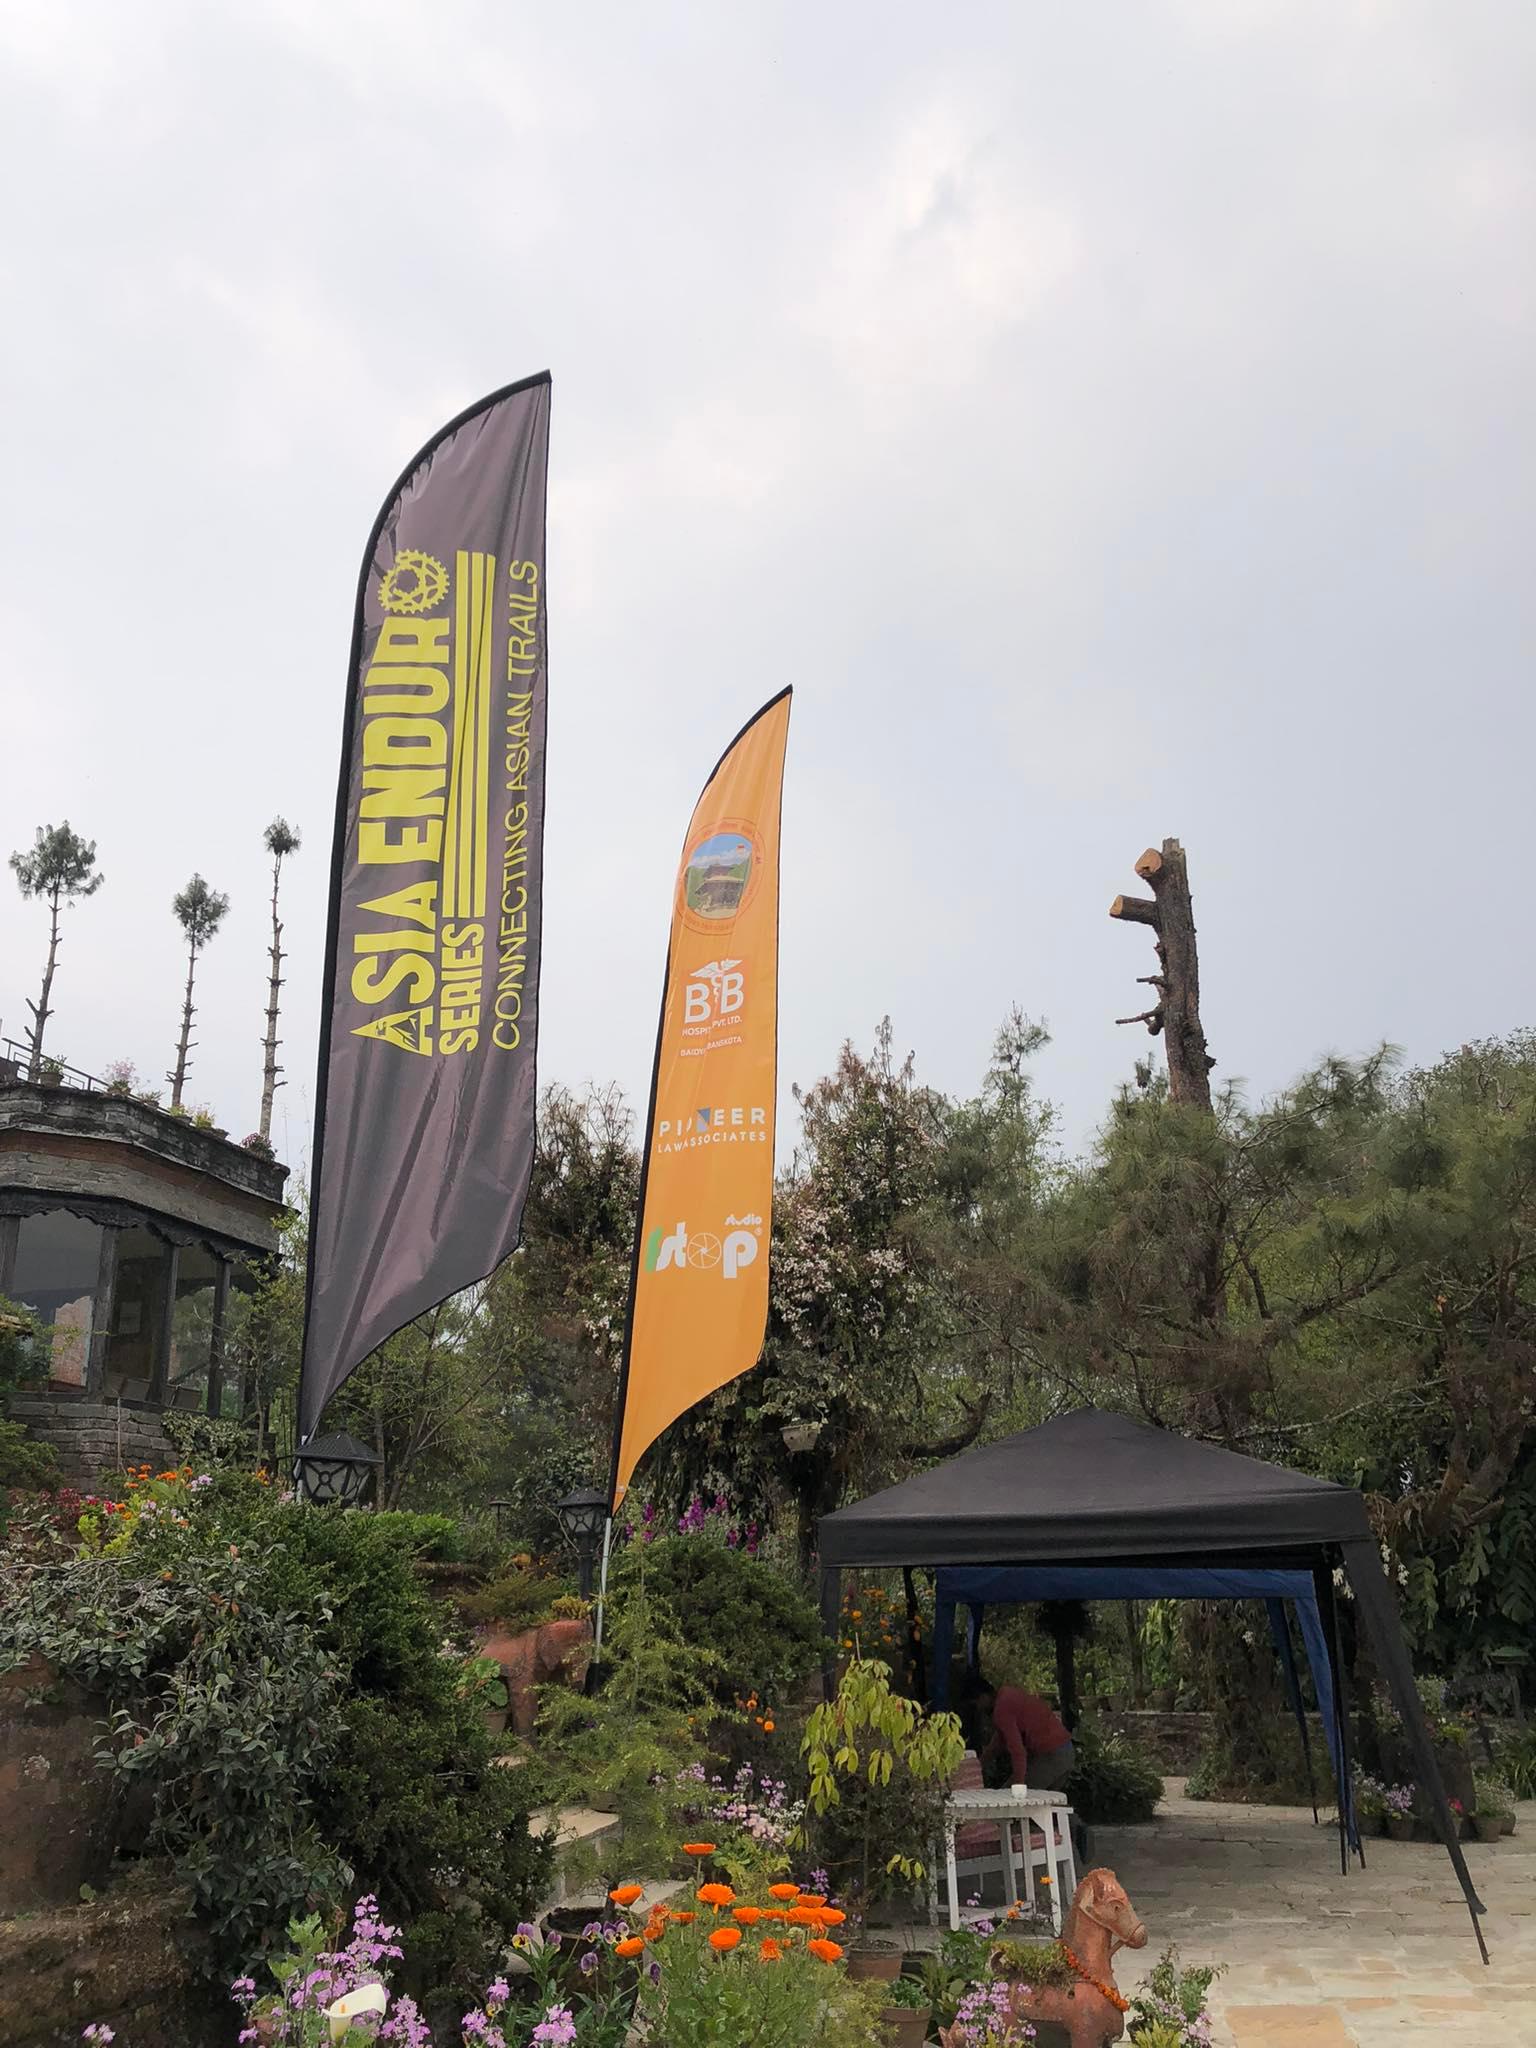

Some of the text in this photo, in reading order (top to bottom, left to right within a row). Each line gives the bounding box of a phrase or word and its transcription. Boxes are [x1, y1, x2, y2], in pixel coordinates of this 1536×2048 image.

[492, 560, 539, 1050] CONNECTING ASIAN TRAILS
[350, 880, 438, 1057] ASIA
[438, 923, 485, 1055] SERIES
[657, 1142, 682, 1153] LAW
